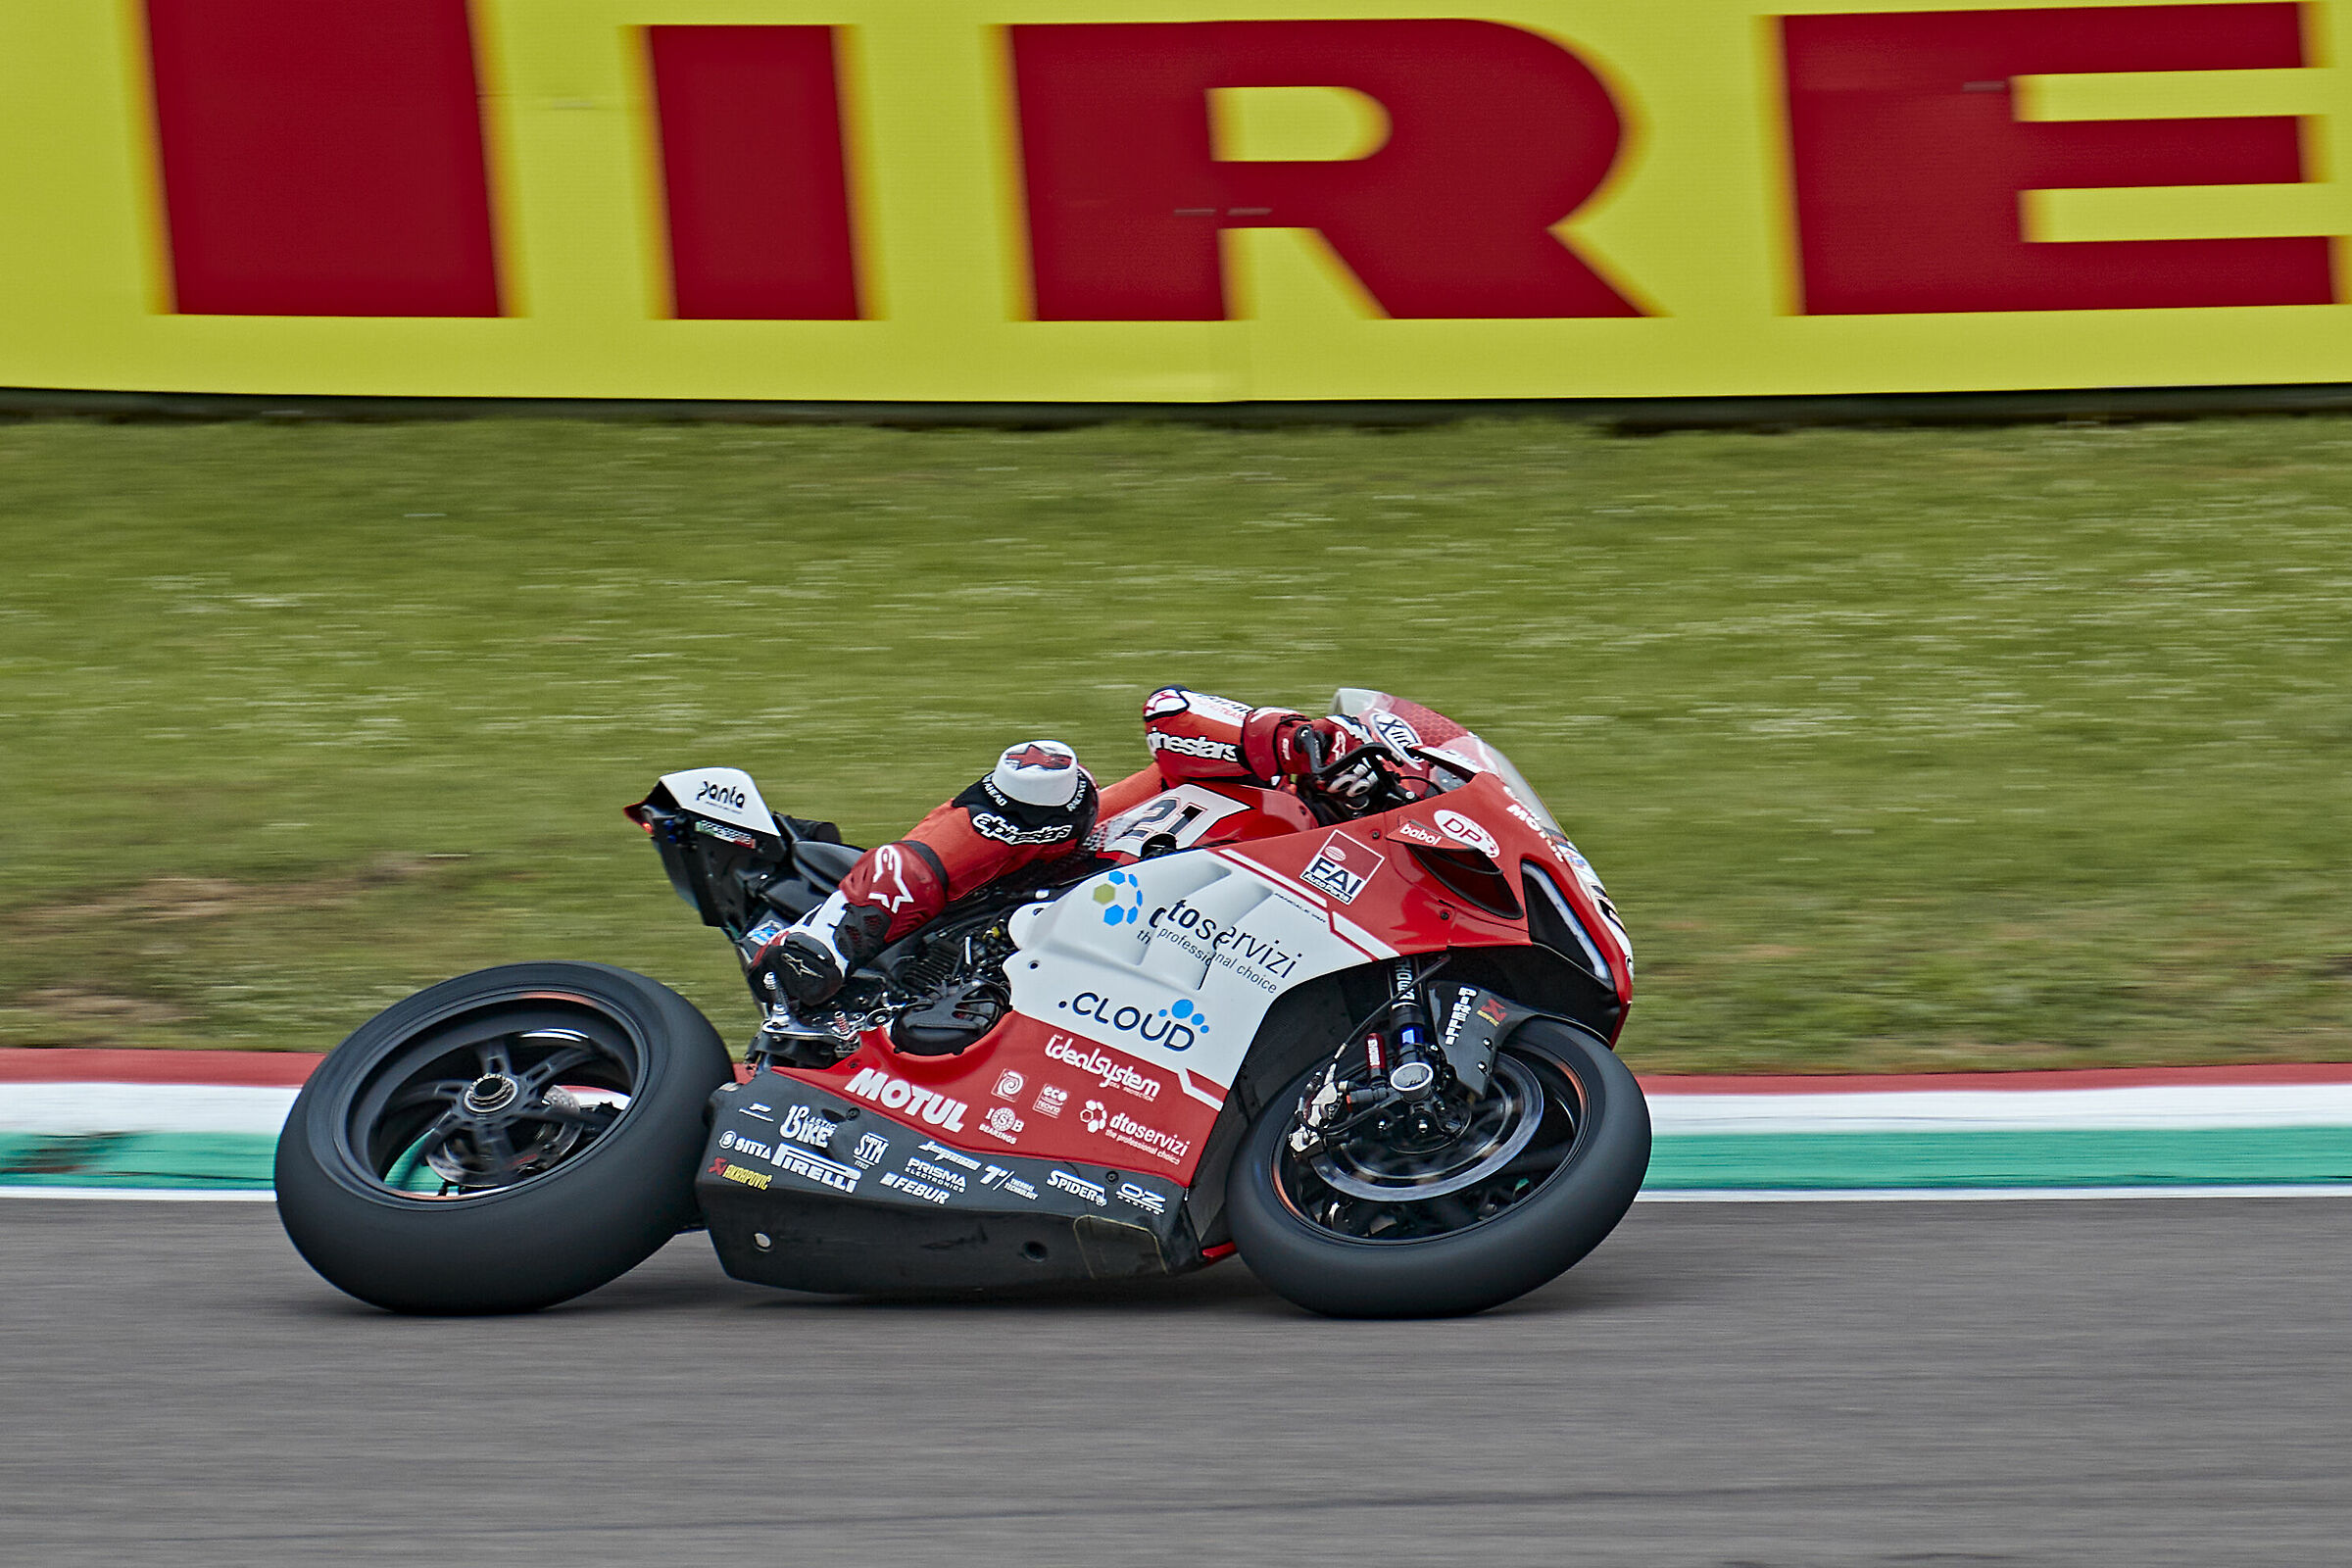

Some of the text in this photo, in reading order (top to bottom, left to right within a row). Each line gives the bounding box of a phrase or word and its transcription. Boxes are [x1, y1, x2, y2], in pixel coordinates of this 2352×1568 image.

[696, 780, 746, 809] panta
[1117, 797, 1208, 842] 21
[1399, 823, 1443, 846] babol
[1442, 817, 1483, 844] DP
[1505, 804, 1565, 863] MOTUL
[1304, 872, 1330, 891] Auto
[1310, 857, 1362, 896] FAI
[1236, 961, 1278, 994] choice
[1445, 986, 1478, 1047] PIRELLI
[844, 1066, 969, 1134] MOTUL
[1044, 1086, 1068, 1102] eco
[853, 1134, 889, 1164] STM
[978, 1123, 1017, 1145] BEARINGS
[1104, 1129, 1119, 1142] the
[1155, 1150, 1181, 1166] choice
[1108, 1112, 1191, 1157] dtoservizi
[769, 1142, 862, 1195] PIRELLI
[904, 1166, 966, 1194] ELECTRONICS
[906, 1156, 966, 1189] PRISMA
[892, 1175, 951, 1204] FEBUR
[1046, 1169, 1104, 1203] SPIDER
